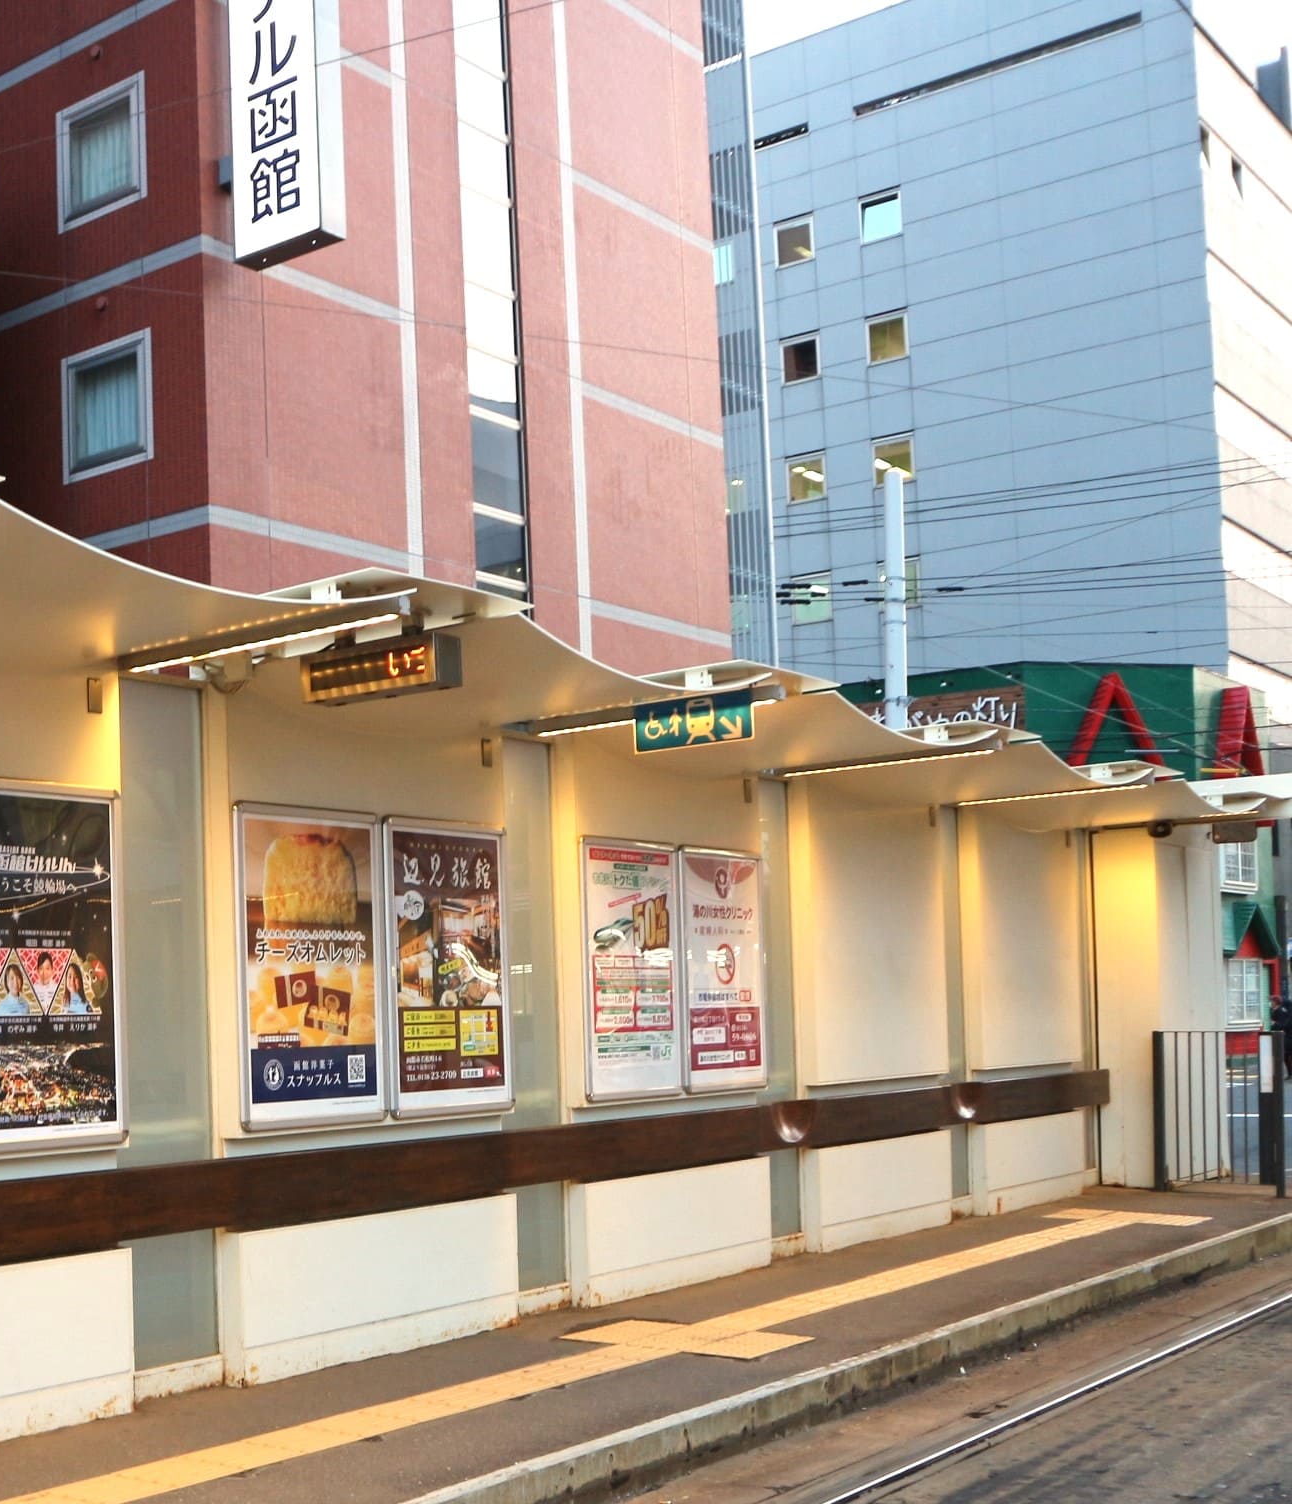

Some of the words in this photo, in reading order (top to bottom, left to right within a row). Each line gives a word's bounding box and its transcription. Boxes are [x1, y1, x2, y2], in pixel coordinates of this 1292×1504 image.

[248, 0, 300, 224] ル函館
[693, 904, 752, 920] 湯の川女性クリニック
[255, 940, 366, 966] チーズオムレット
[293, 1058, 335, 1072] 函館洋菓子
[430, 1069, 457, 1080] 23-2709
